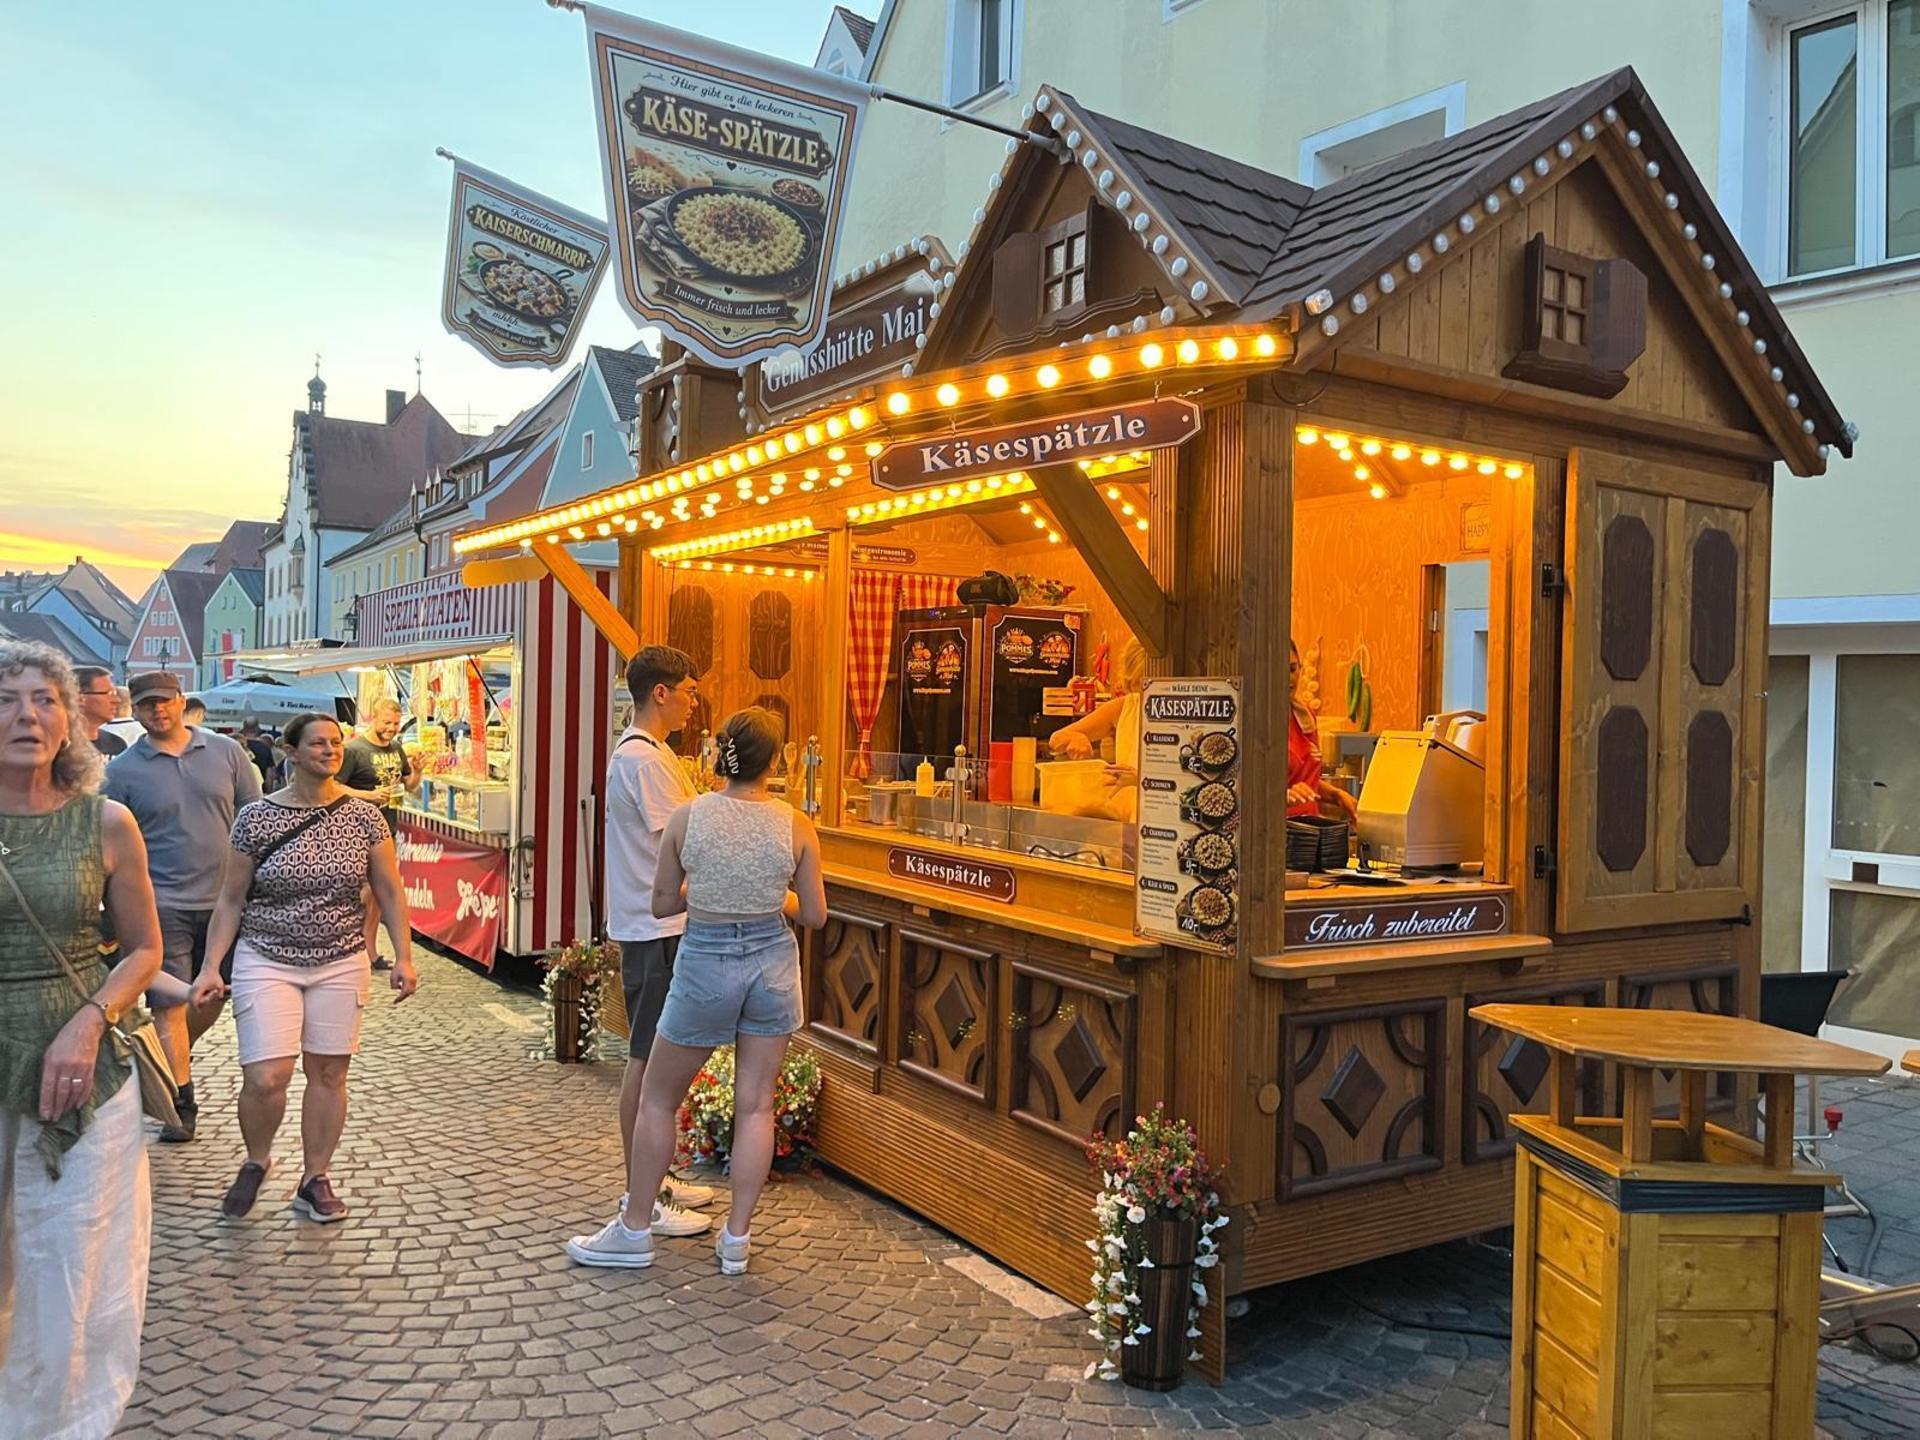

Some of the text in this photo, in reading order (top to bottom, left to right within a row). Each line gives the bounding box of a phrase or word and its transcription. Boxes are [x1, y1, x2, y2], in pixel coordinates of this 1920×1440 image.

[670, 75, 795, 119] Hier gibt es die leckeren
[642, 95, 819, 168] KÄSE-SPÄTZLE
[473, 207, 588, 268] KAISERSCHMARRN
[510, 208, 559, 235] Köstlicher
[674, 284, 781, 316] Immer frisch und lecker
[766, 326, 875, 393] Genusshütte
[920, 413, 1147, 475] Käsespätzle
[384, 583, 471, 633] SPEZIALITÄTEN
[402, 877, 435, 910] ndeln
[905, 854, 992, 889] Käsespätzle
[1305, 905, 1478, 944] Frisch zubereitet
